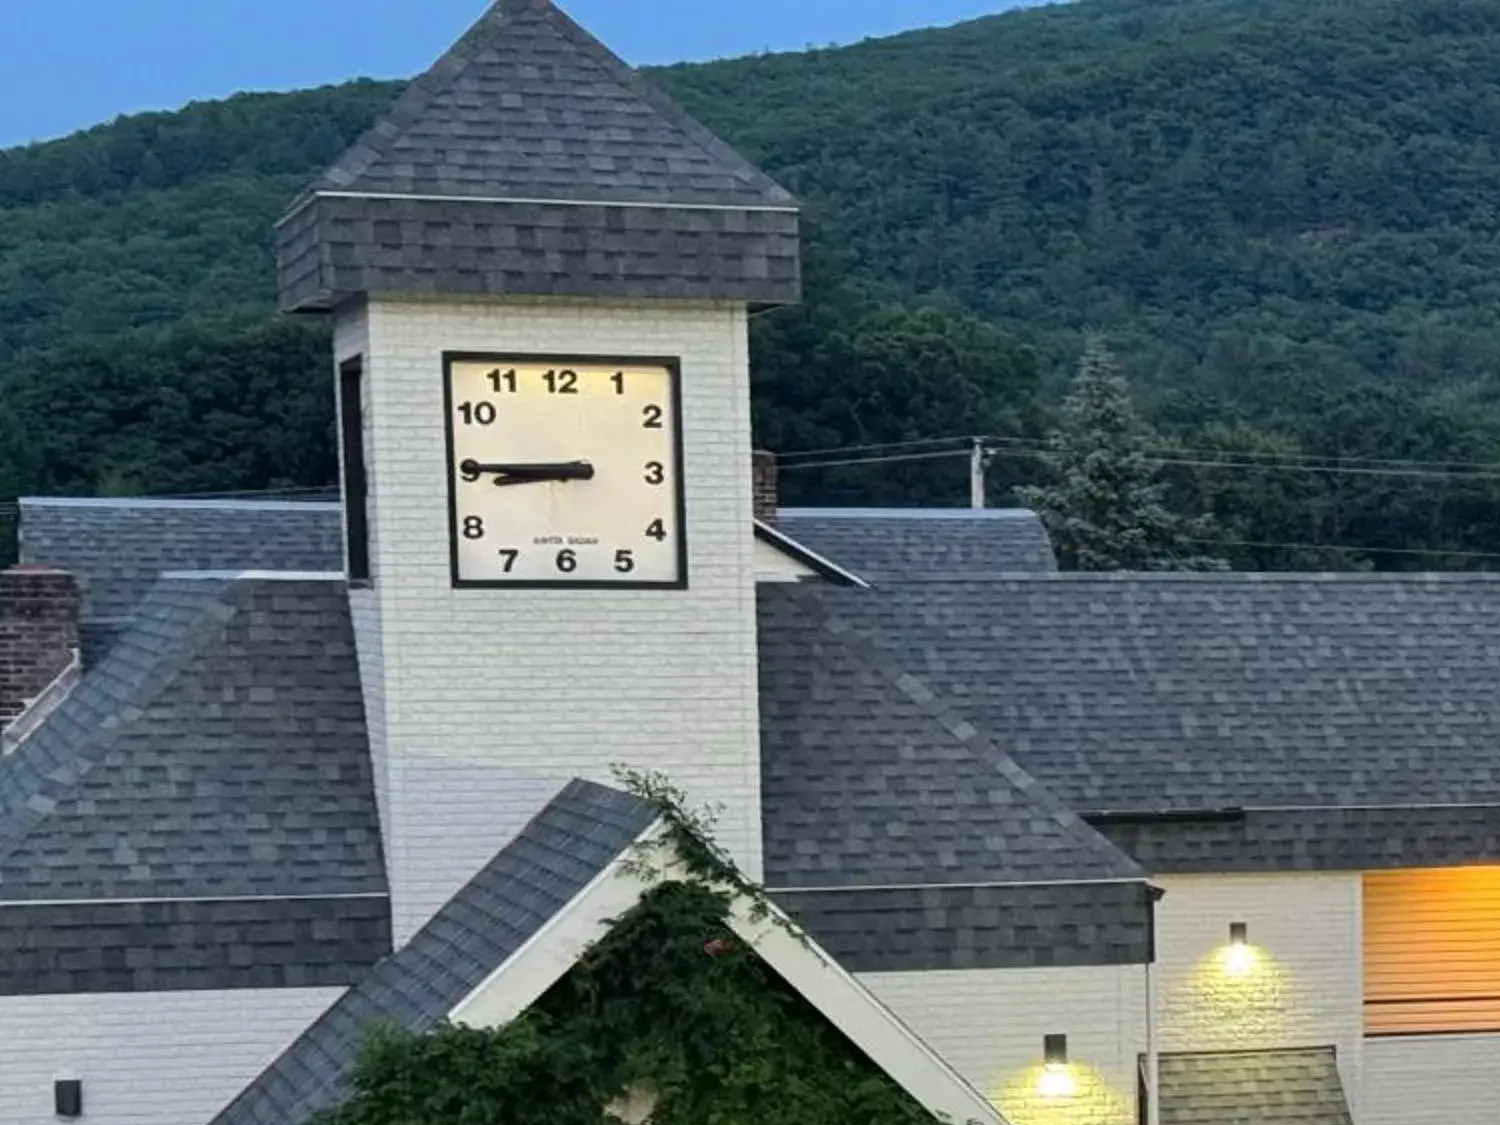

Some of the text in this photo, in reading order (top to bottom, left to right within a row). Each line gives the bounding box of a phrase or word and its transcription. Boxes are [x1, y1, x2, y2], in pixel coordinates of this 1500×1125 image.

[487, 369, 517, 393] 11
[542, 370, 578, 394] 12
[610, 371, 624, 395] 1
[457, 401, 496, 425] 10
[643, 405, 662, 428] 2
[645, 462, 664, 485] 3
[463, 516, 484, 539] 8
[646, 519, 666, 541] 4
[499, 549, 518, 572] 7
[556, 549, 576, 572] 6
[614, 550, 634, 572] 5
